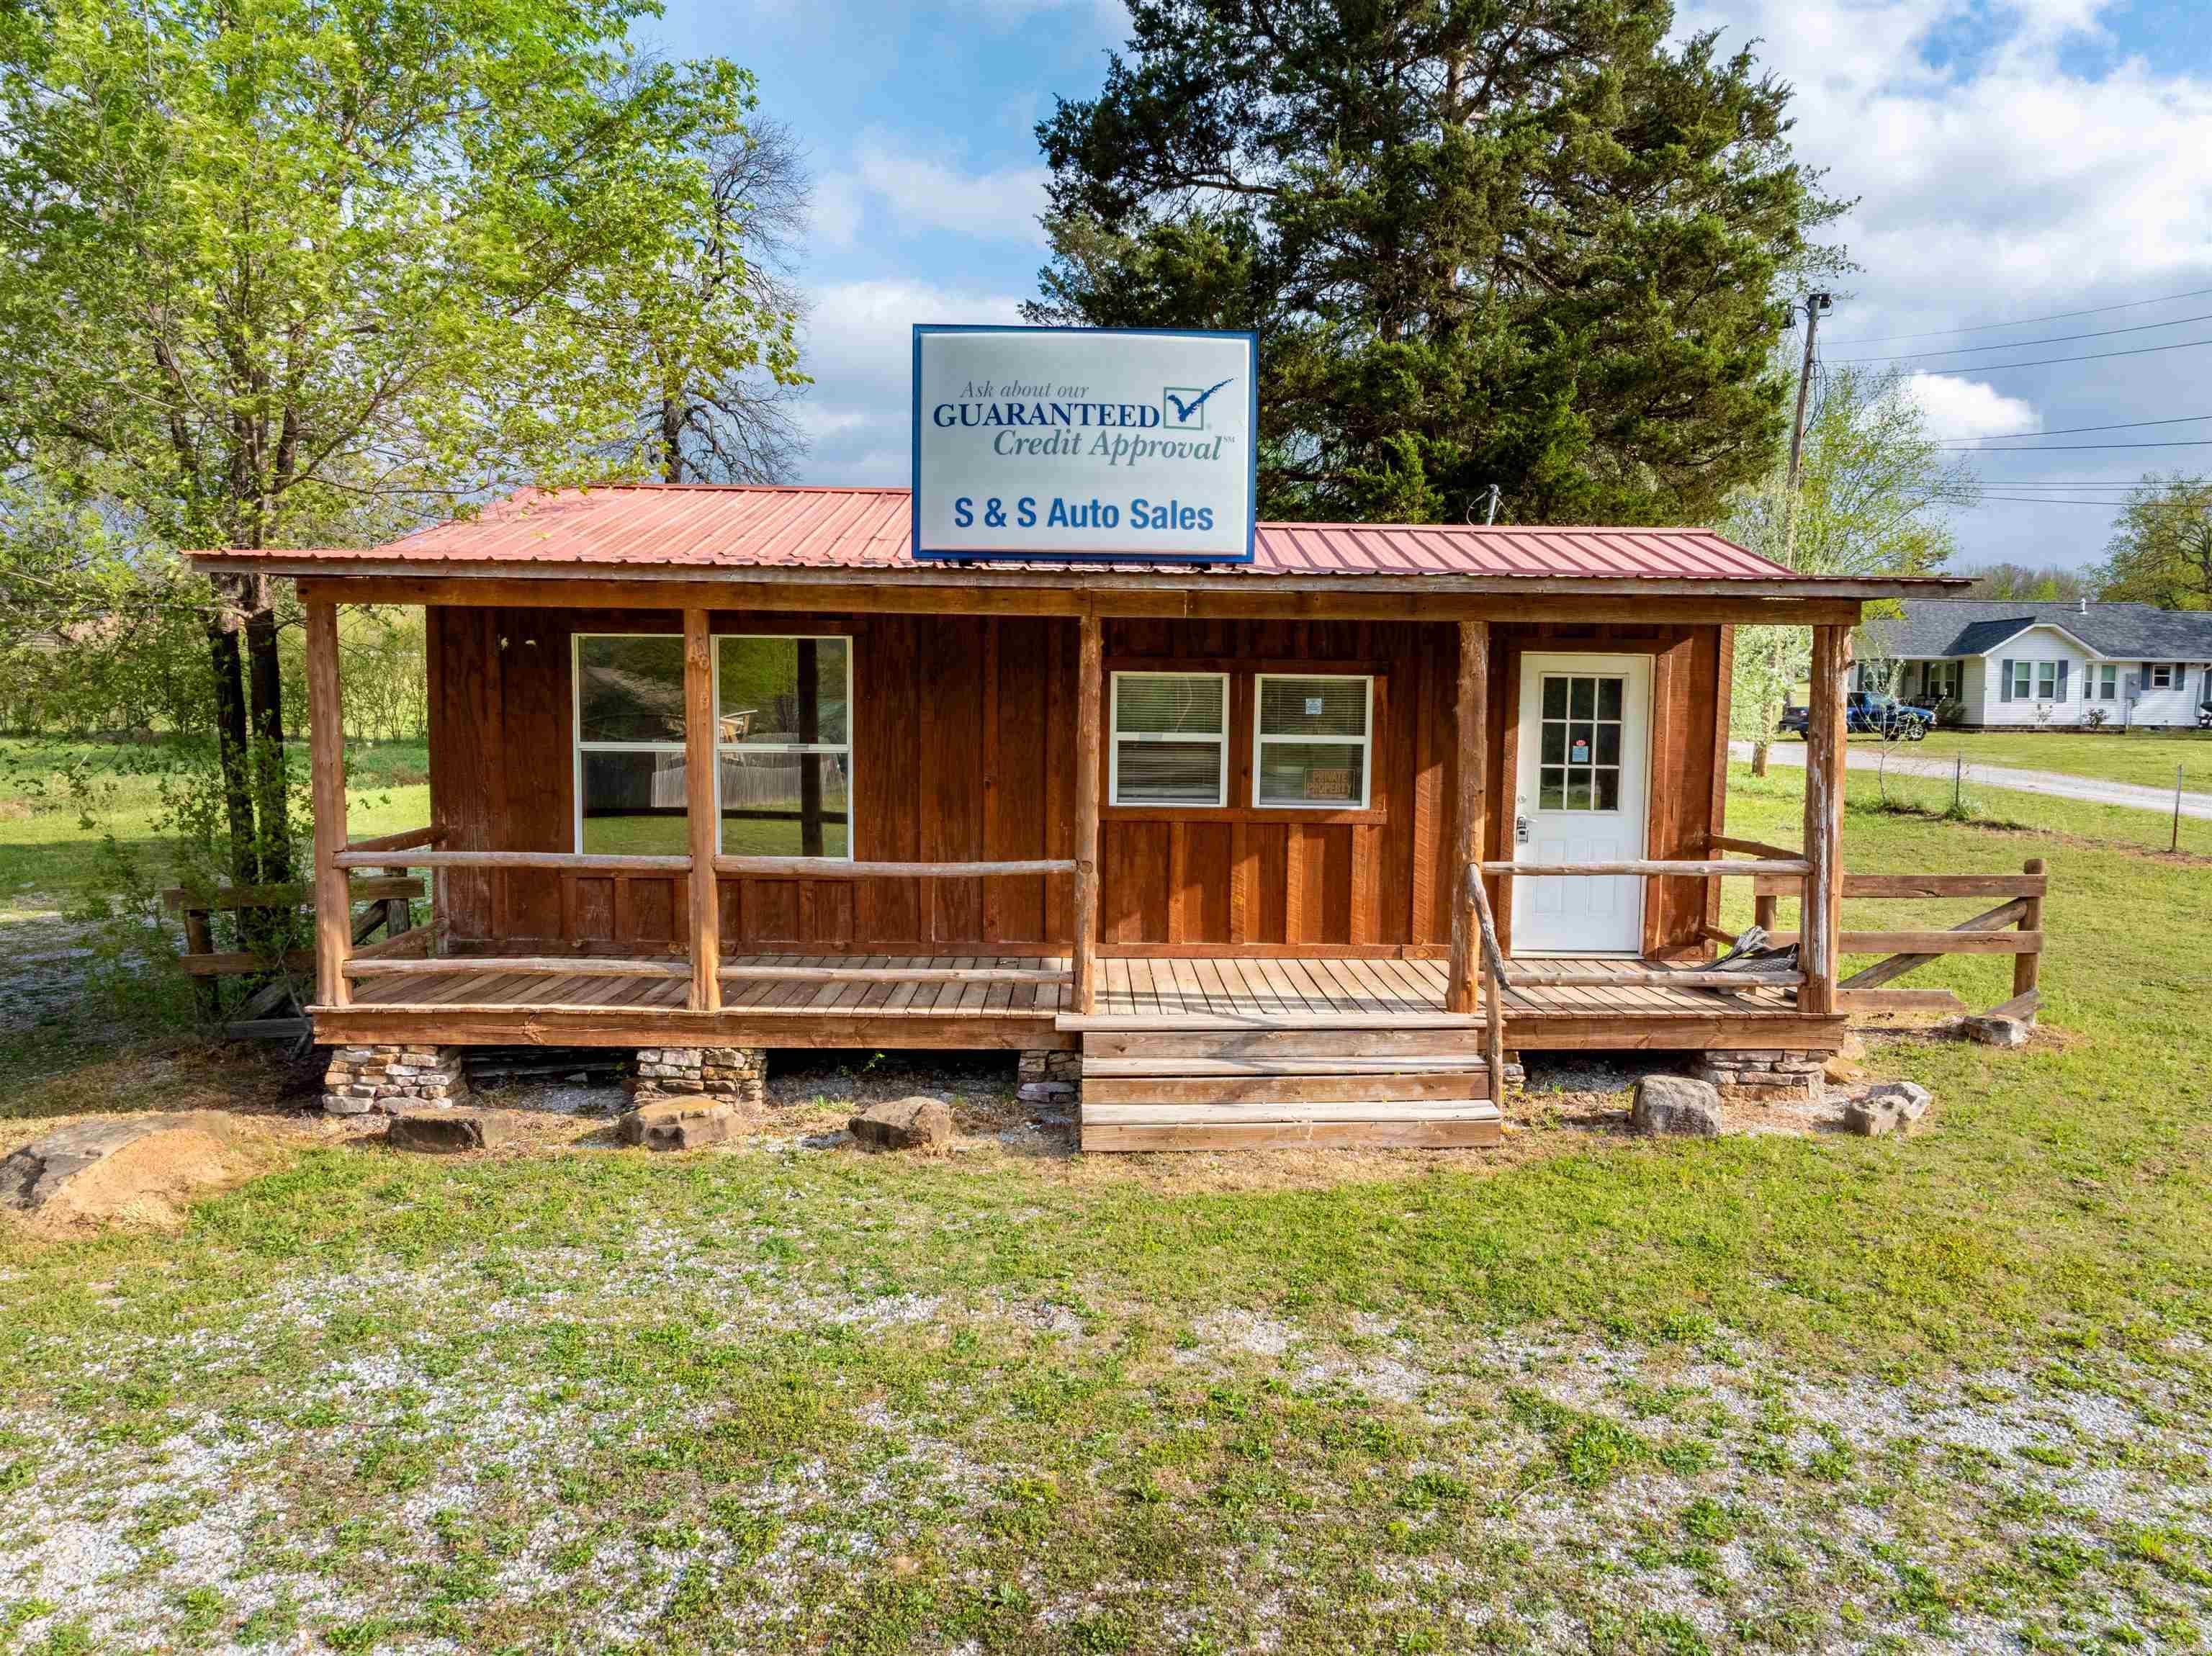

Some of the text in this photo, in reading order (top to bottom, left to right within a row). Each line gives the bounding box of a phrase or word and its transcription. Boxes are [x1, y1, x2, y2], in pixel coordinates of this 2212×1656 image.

[960, 380, 1089, 398] Ask about our
[933, 402, 1160, 428] GUARANTEED
[994, 429, 1082, 455] Credit
[1088, 429, 1222, 466] Approval
[955, 497, 1214, 531] S & S Auto Sales
[1313, 771, 1348, 782] PRIVATE
[1307, 783, 1352, 793] PROPERTY
